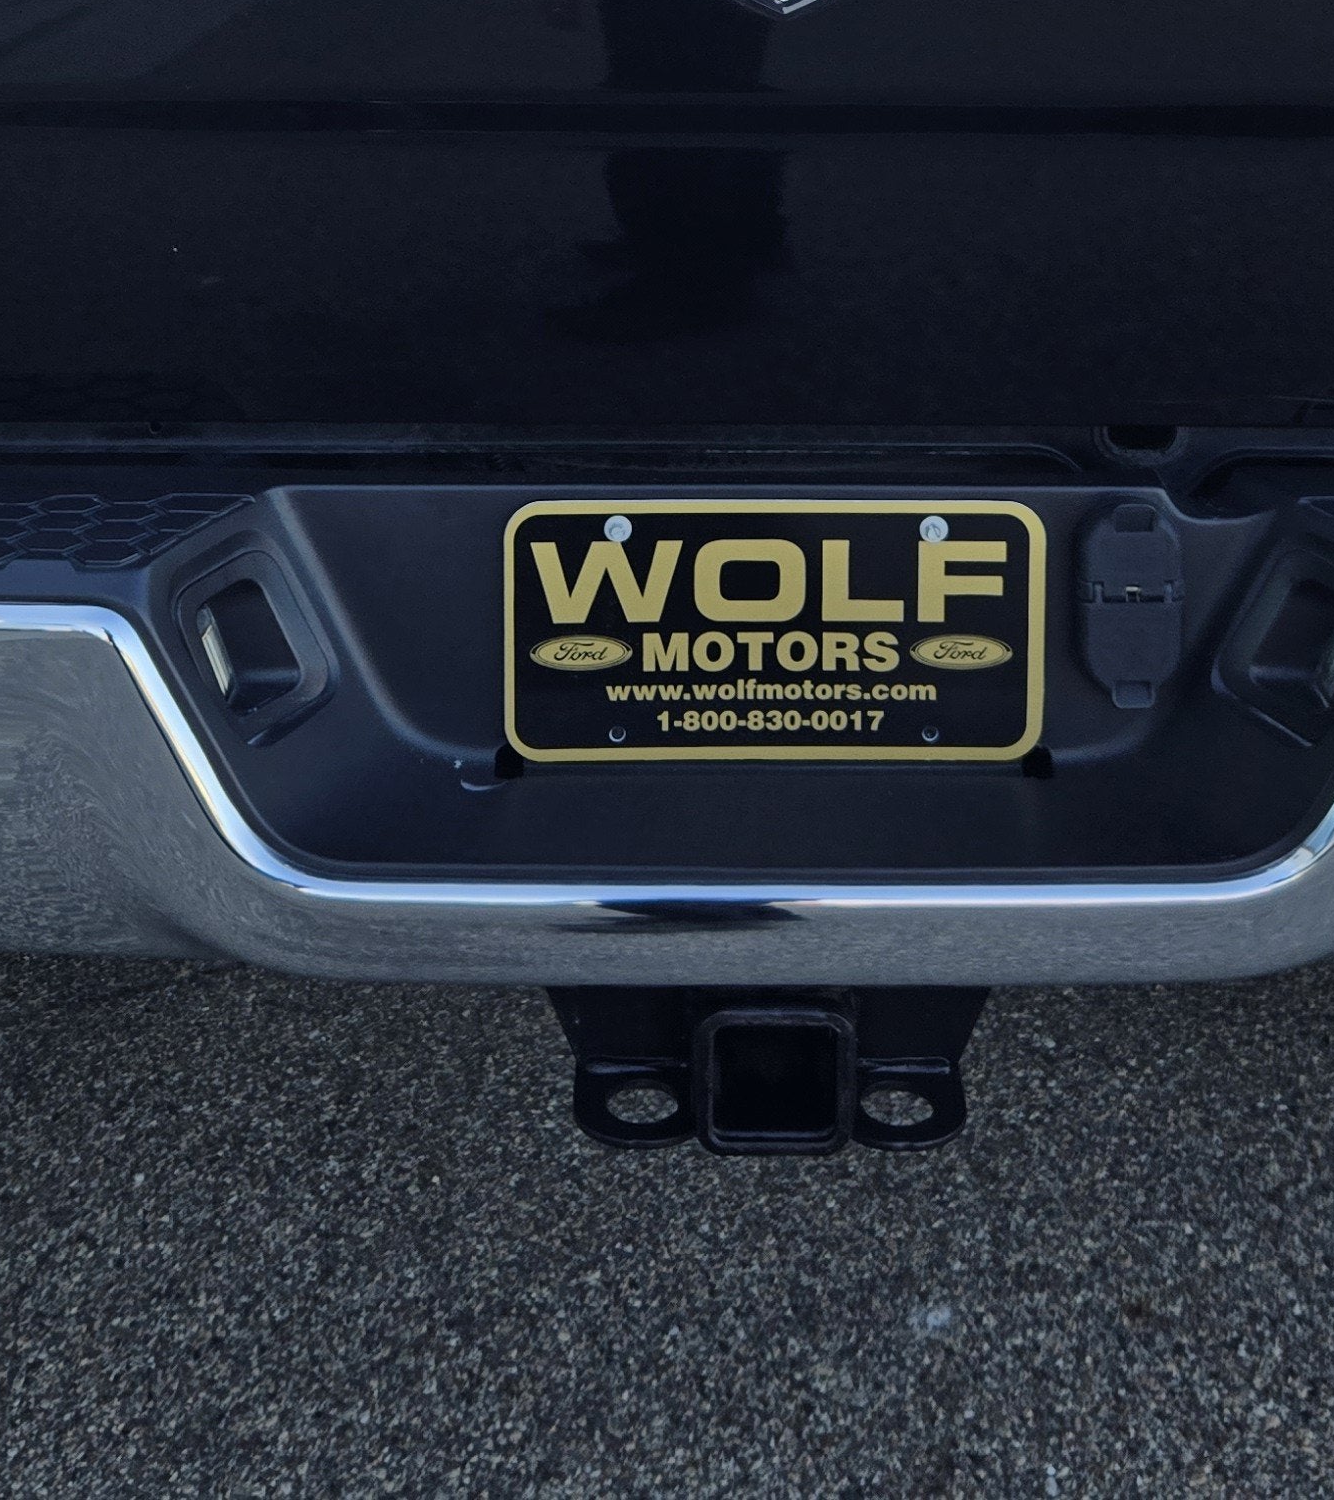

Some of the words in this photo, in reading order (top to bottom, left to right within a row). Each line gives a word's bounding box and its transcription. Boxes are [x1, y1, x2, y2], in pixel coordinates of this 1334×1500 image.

[529, 539, 1007, 624] WOLF
[553, 638, 609, 662] Ford
[642, 632, 900, 672] MOTORS
[932, 638, 988, 662] Ford
[605, 678, 938, 702] www.wolfmotors.com
[656, 710, 885, 732] 1-800-830-0017
